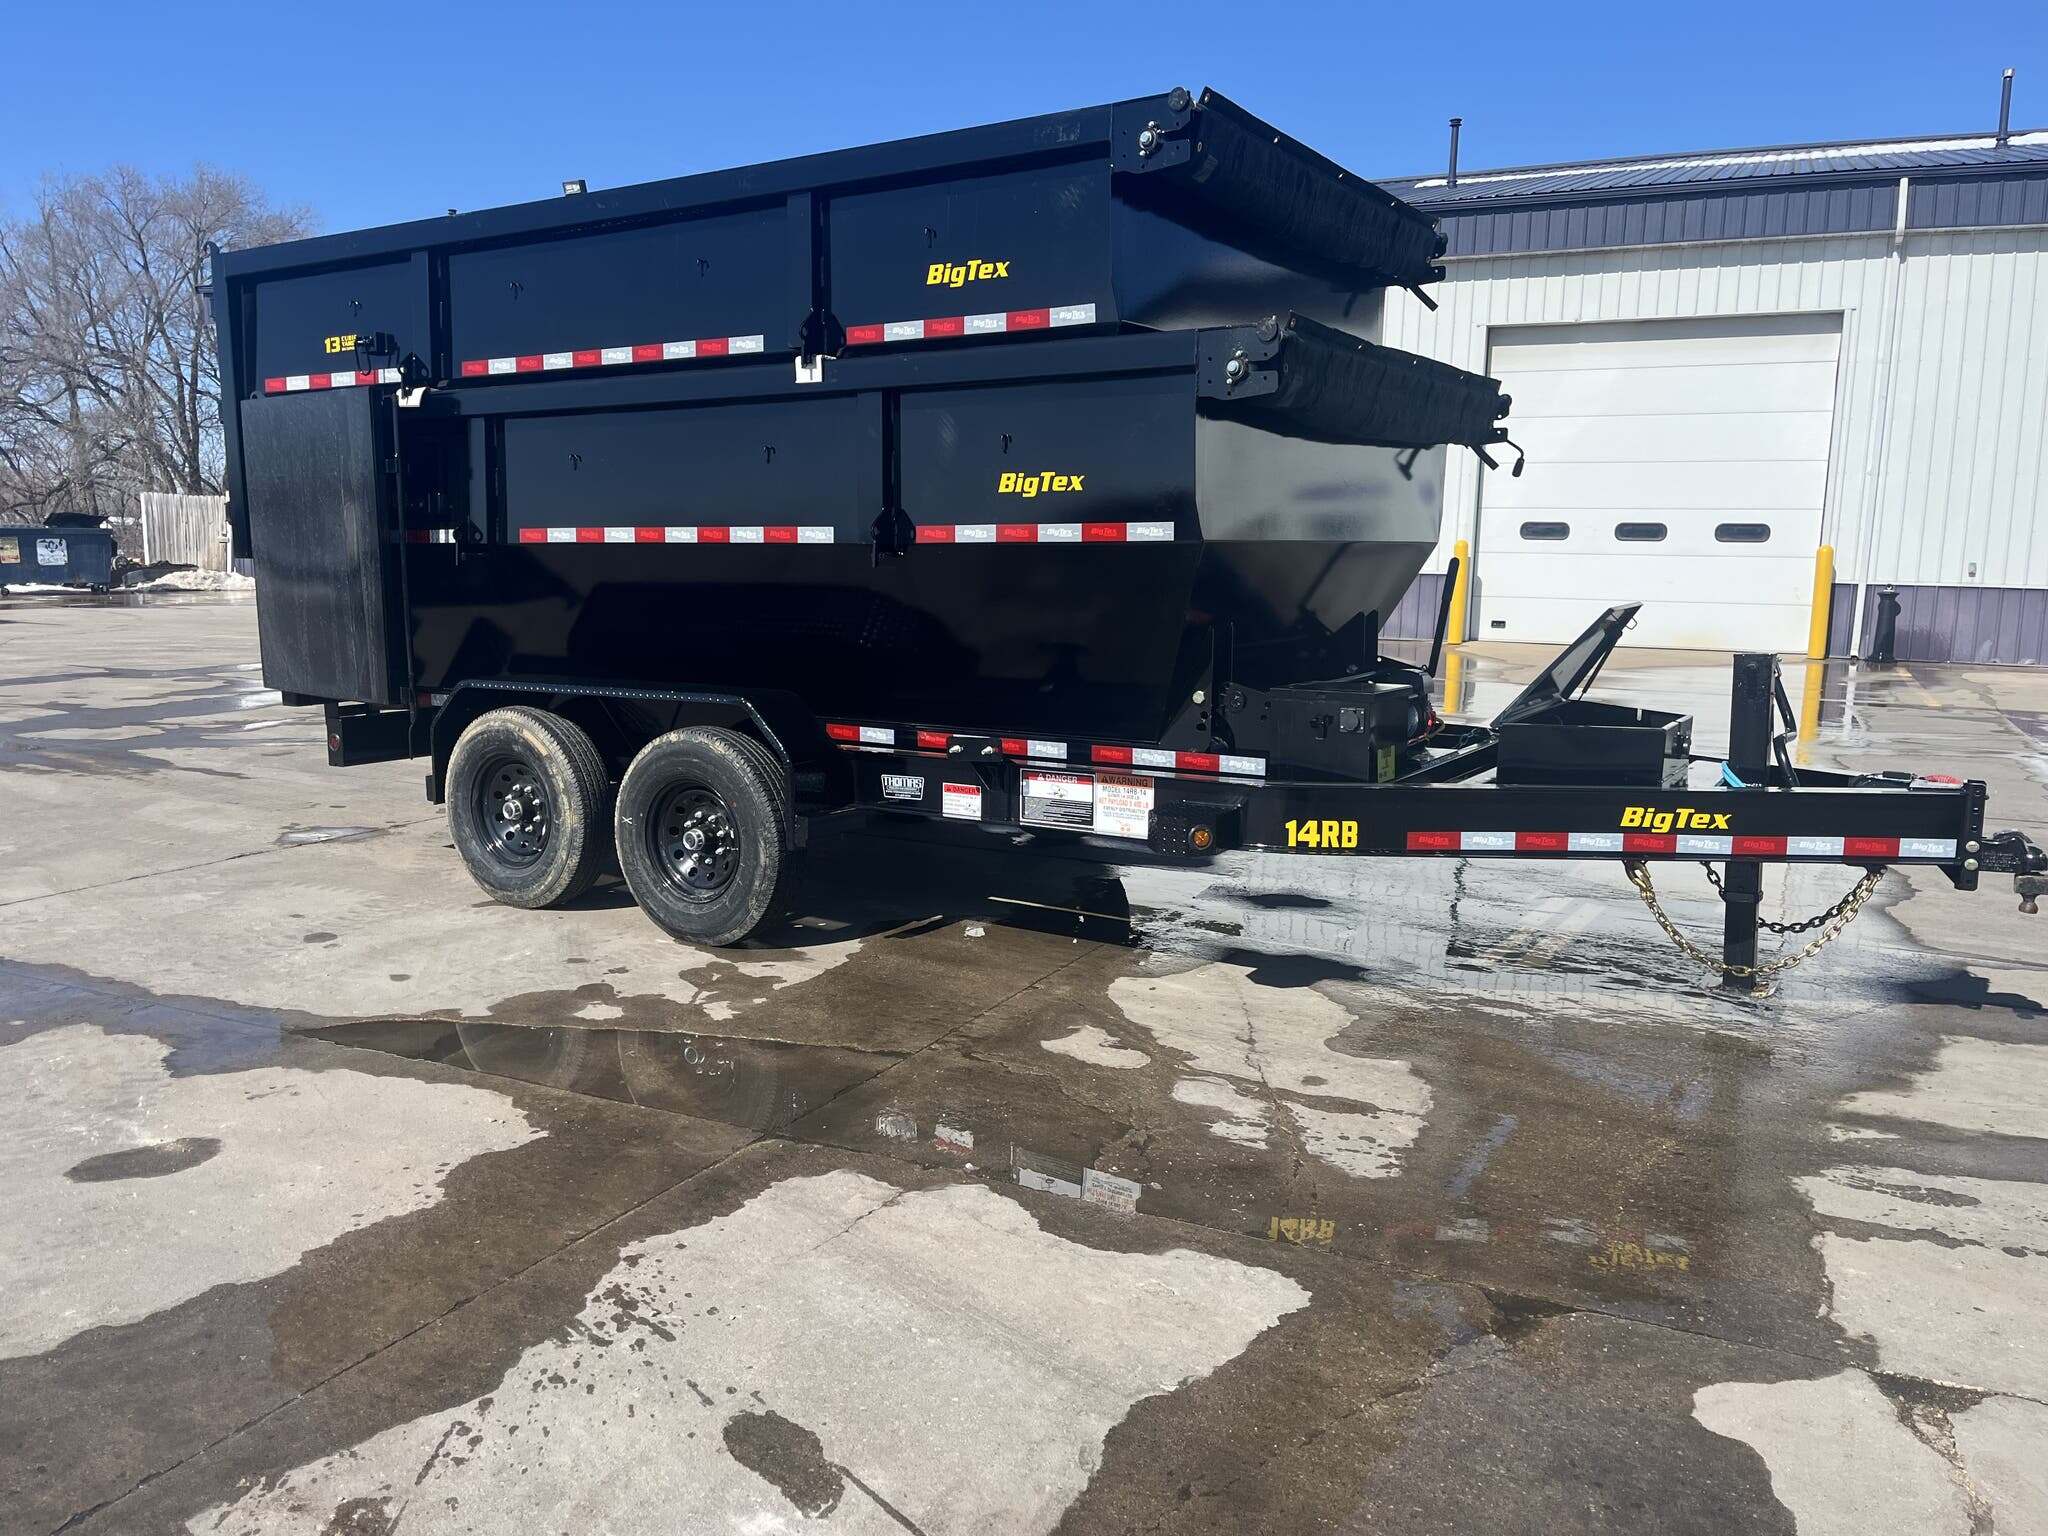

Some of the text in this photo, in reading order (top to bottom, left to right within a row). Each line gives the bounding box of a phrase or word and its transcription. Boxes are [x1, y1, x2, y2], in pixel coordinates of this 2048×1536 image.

[926, 259, 1010, 288] BigTex
[324, 336, 340, 353] 13
[998, 471, 1085, 498] BigTex
[884, 777, 922, 788] THOMAS
[1045, 774, 1078, 783] DANGER
[1108, 776, 1148, 787] WARNING
[1620, 807, 1732, 833] BigTex
[1285, 820, 1358, 848] 14RB
[1472, 836, 1504, 846] BigTex
[1579, 837, 1612, 847] BigTex
[1688, 839, 1721, 850] BigTex
[1799, 841, 1833, 851] BigTex
[1911, 842, 1944, 853] BigTex
